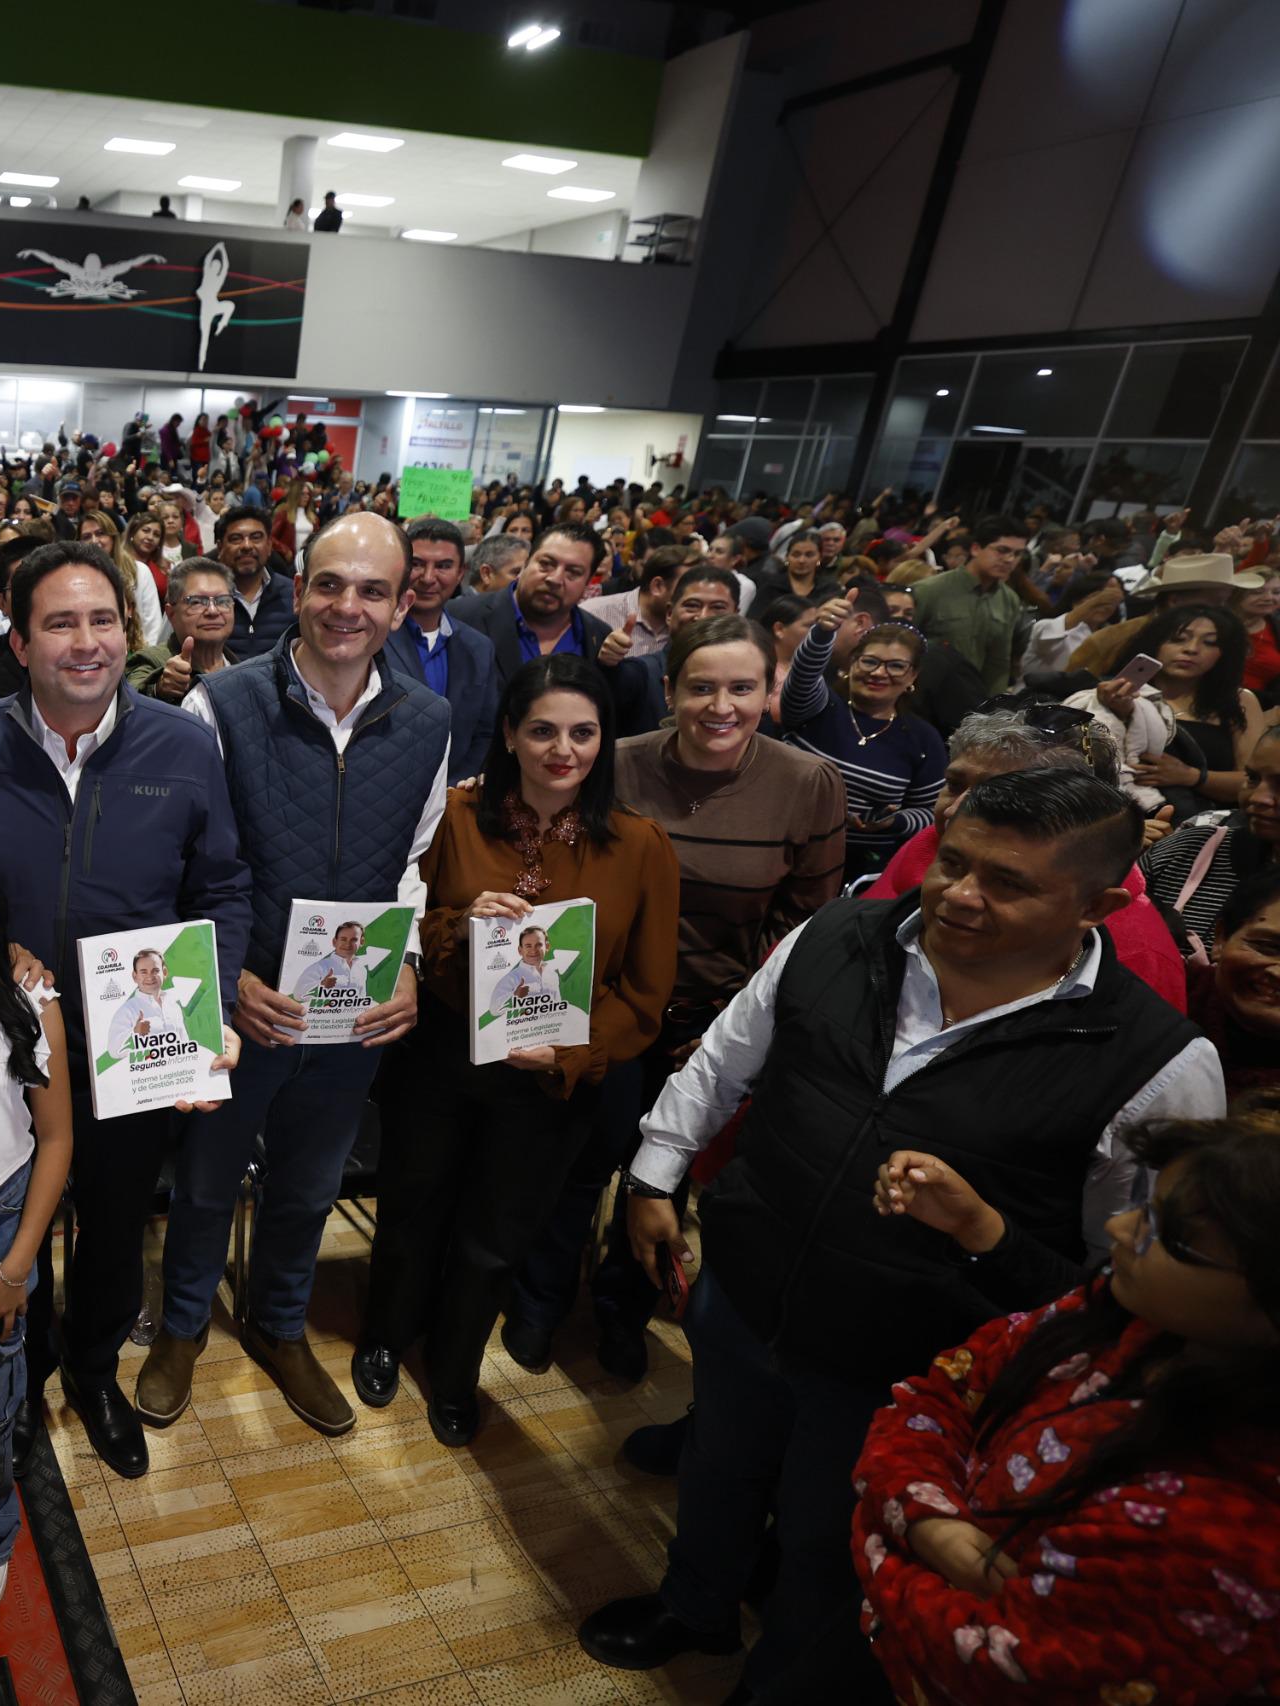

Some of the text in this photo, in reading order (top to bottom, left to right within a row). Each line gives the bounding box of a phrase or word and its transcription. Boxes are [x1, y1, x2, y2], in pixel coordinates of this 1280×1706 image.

[134, 785, 170, 797] KUIU
[506, 1015, 539, 1026] Segundo
[506, 1028, 530, 1037] Informe
[130, 1054, 199, 1072] Segundo Informe
[131, 1068, 196, 1085] Informe Legislativo
[132, 1087, 137, 1095] y
[148, 1080, 174, 1090] Gestión
[175, 1076, 194, 1085] 2026
